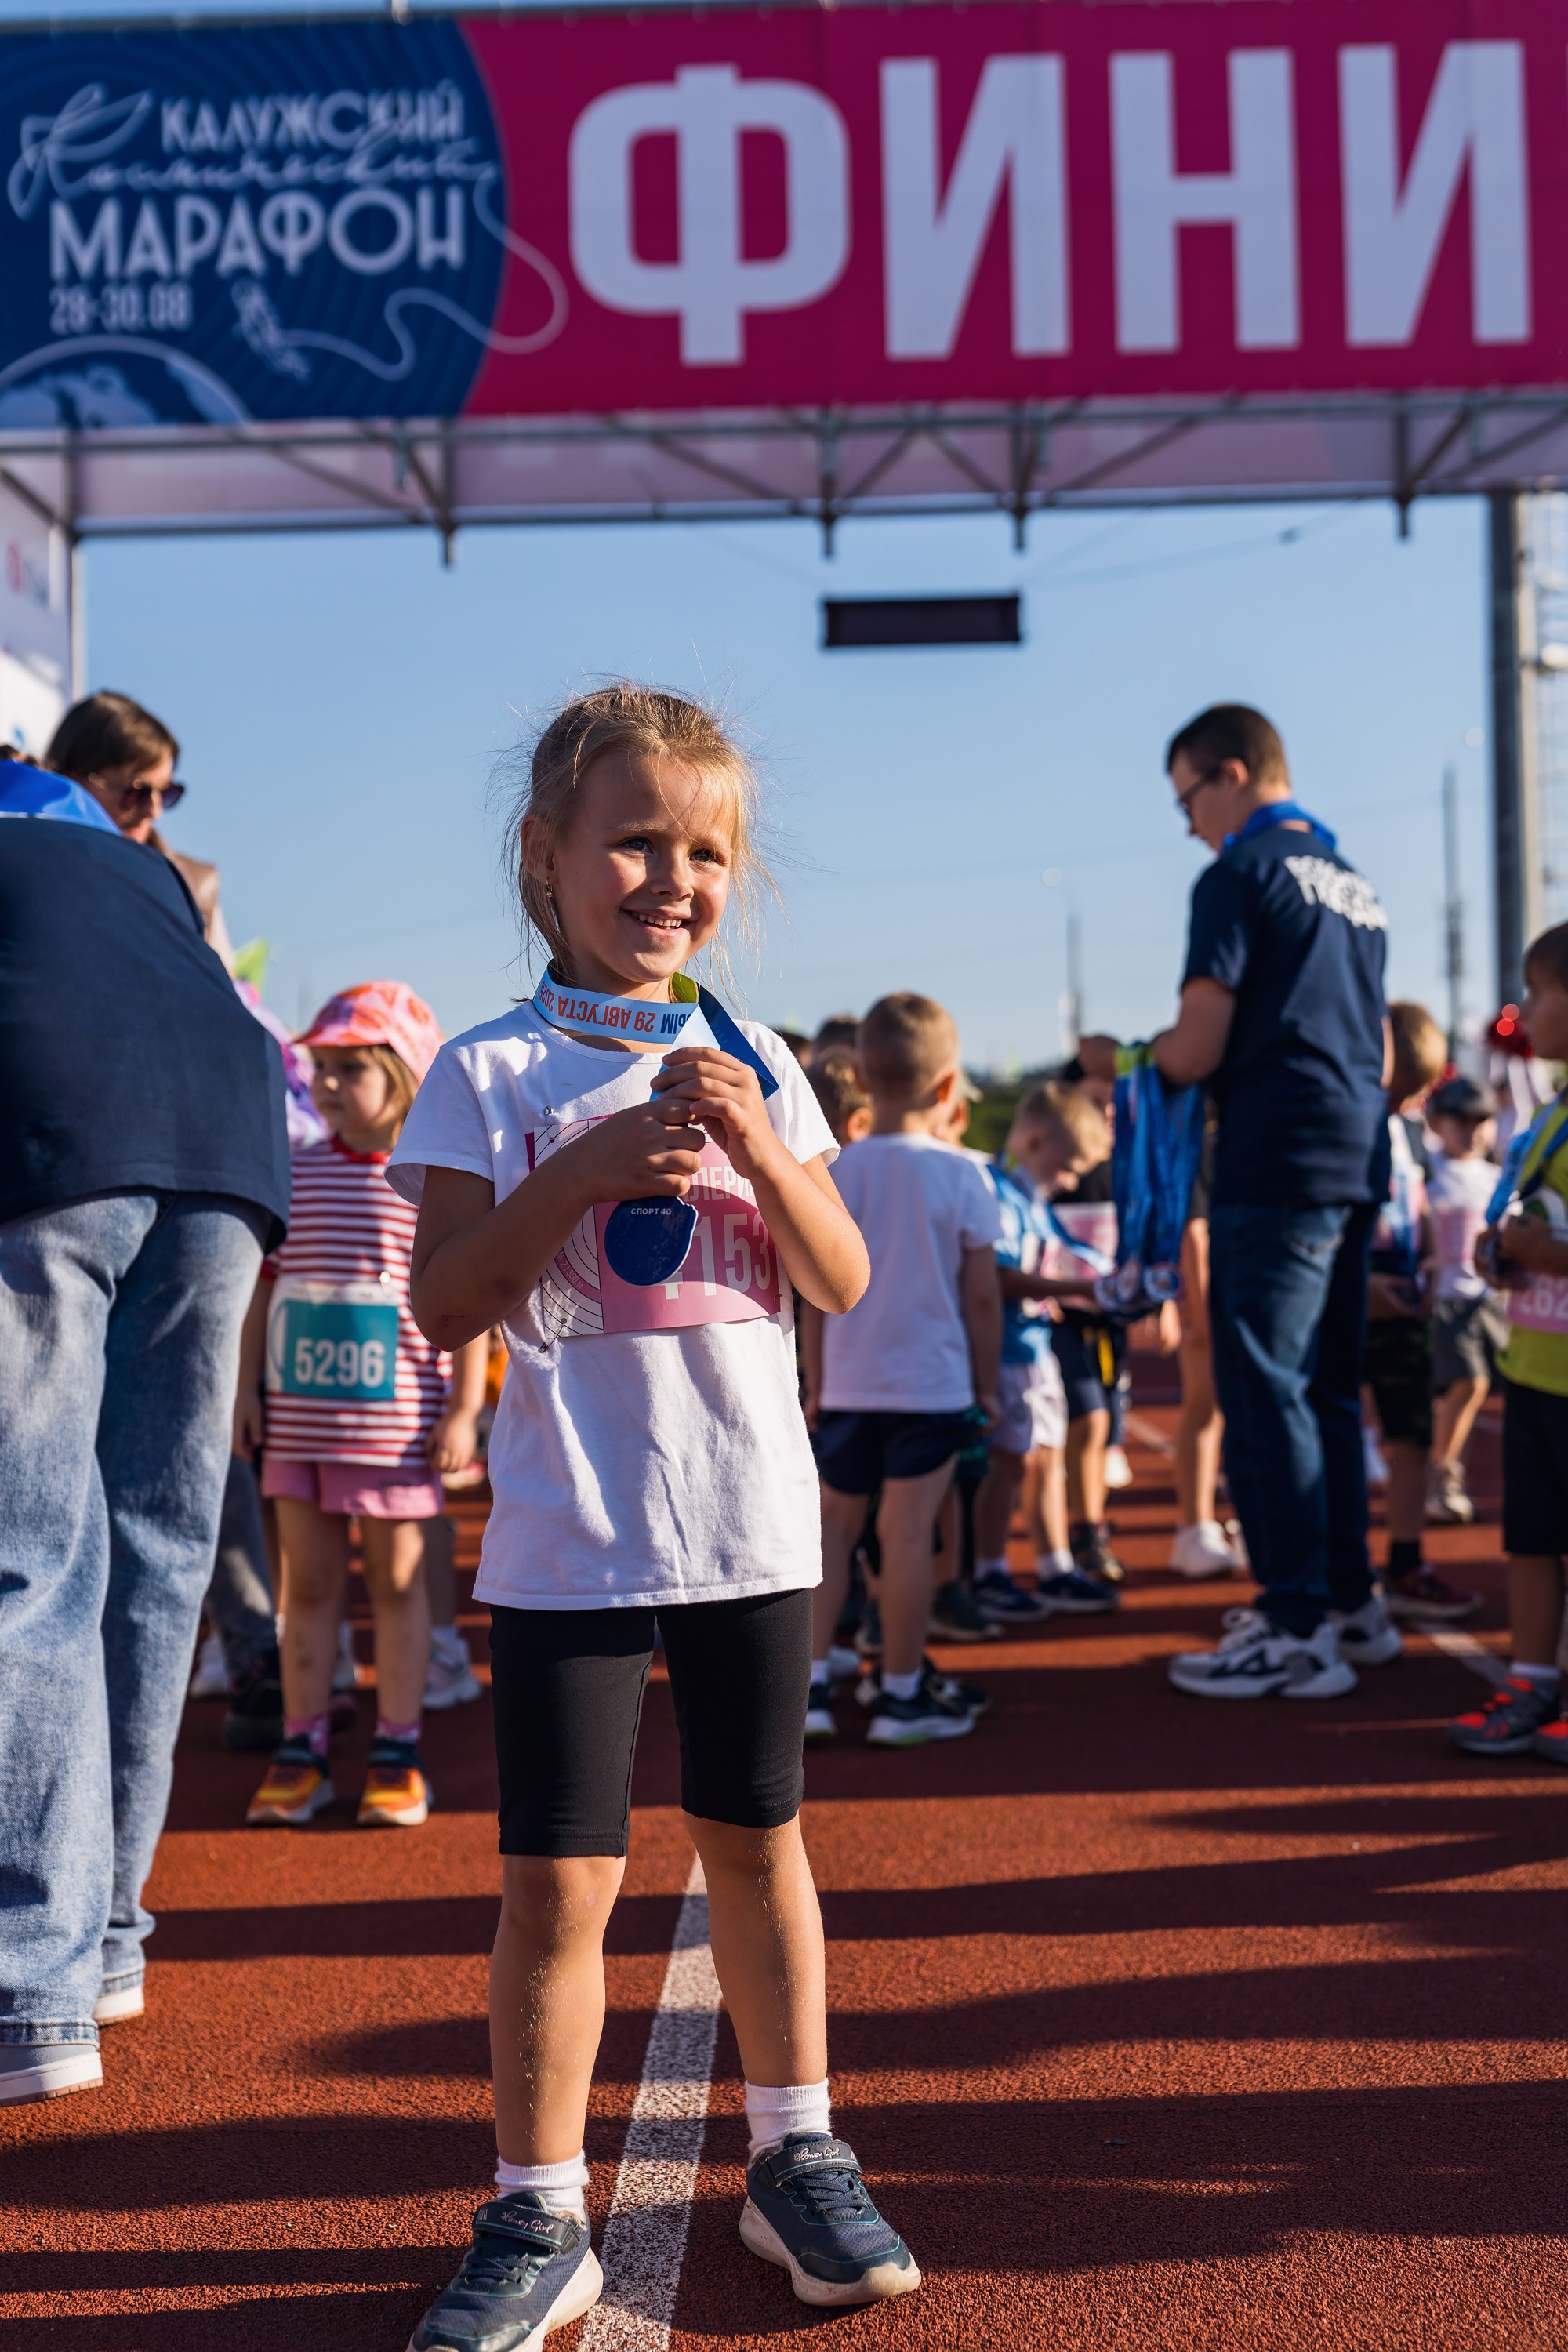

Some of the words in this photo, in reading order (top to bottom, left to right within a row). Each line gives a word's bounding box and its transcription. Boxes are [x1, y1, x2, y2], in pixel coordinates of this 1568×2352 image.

[161, 78, 465, 153] КАЛУЖСКИЙ
[569, 38, 1532, 365] ФИНИ
[49, 185, 466, 279] МАРАФОН
[557, 996, 632, 1029] АВГУСТА
[634, 1011, 656, 1032] 29
[683, 1166, 753, 1202] ЛЕРИ
[566, 1270, 579, 1283] 300
[295, 1337, 386, 1388] 5296
[824, 2147, 840, 2158] Girl
[501, 2211, 528, 2229] Honey
[531, 2220, 554, 2234] Girl
